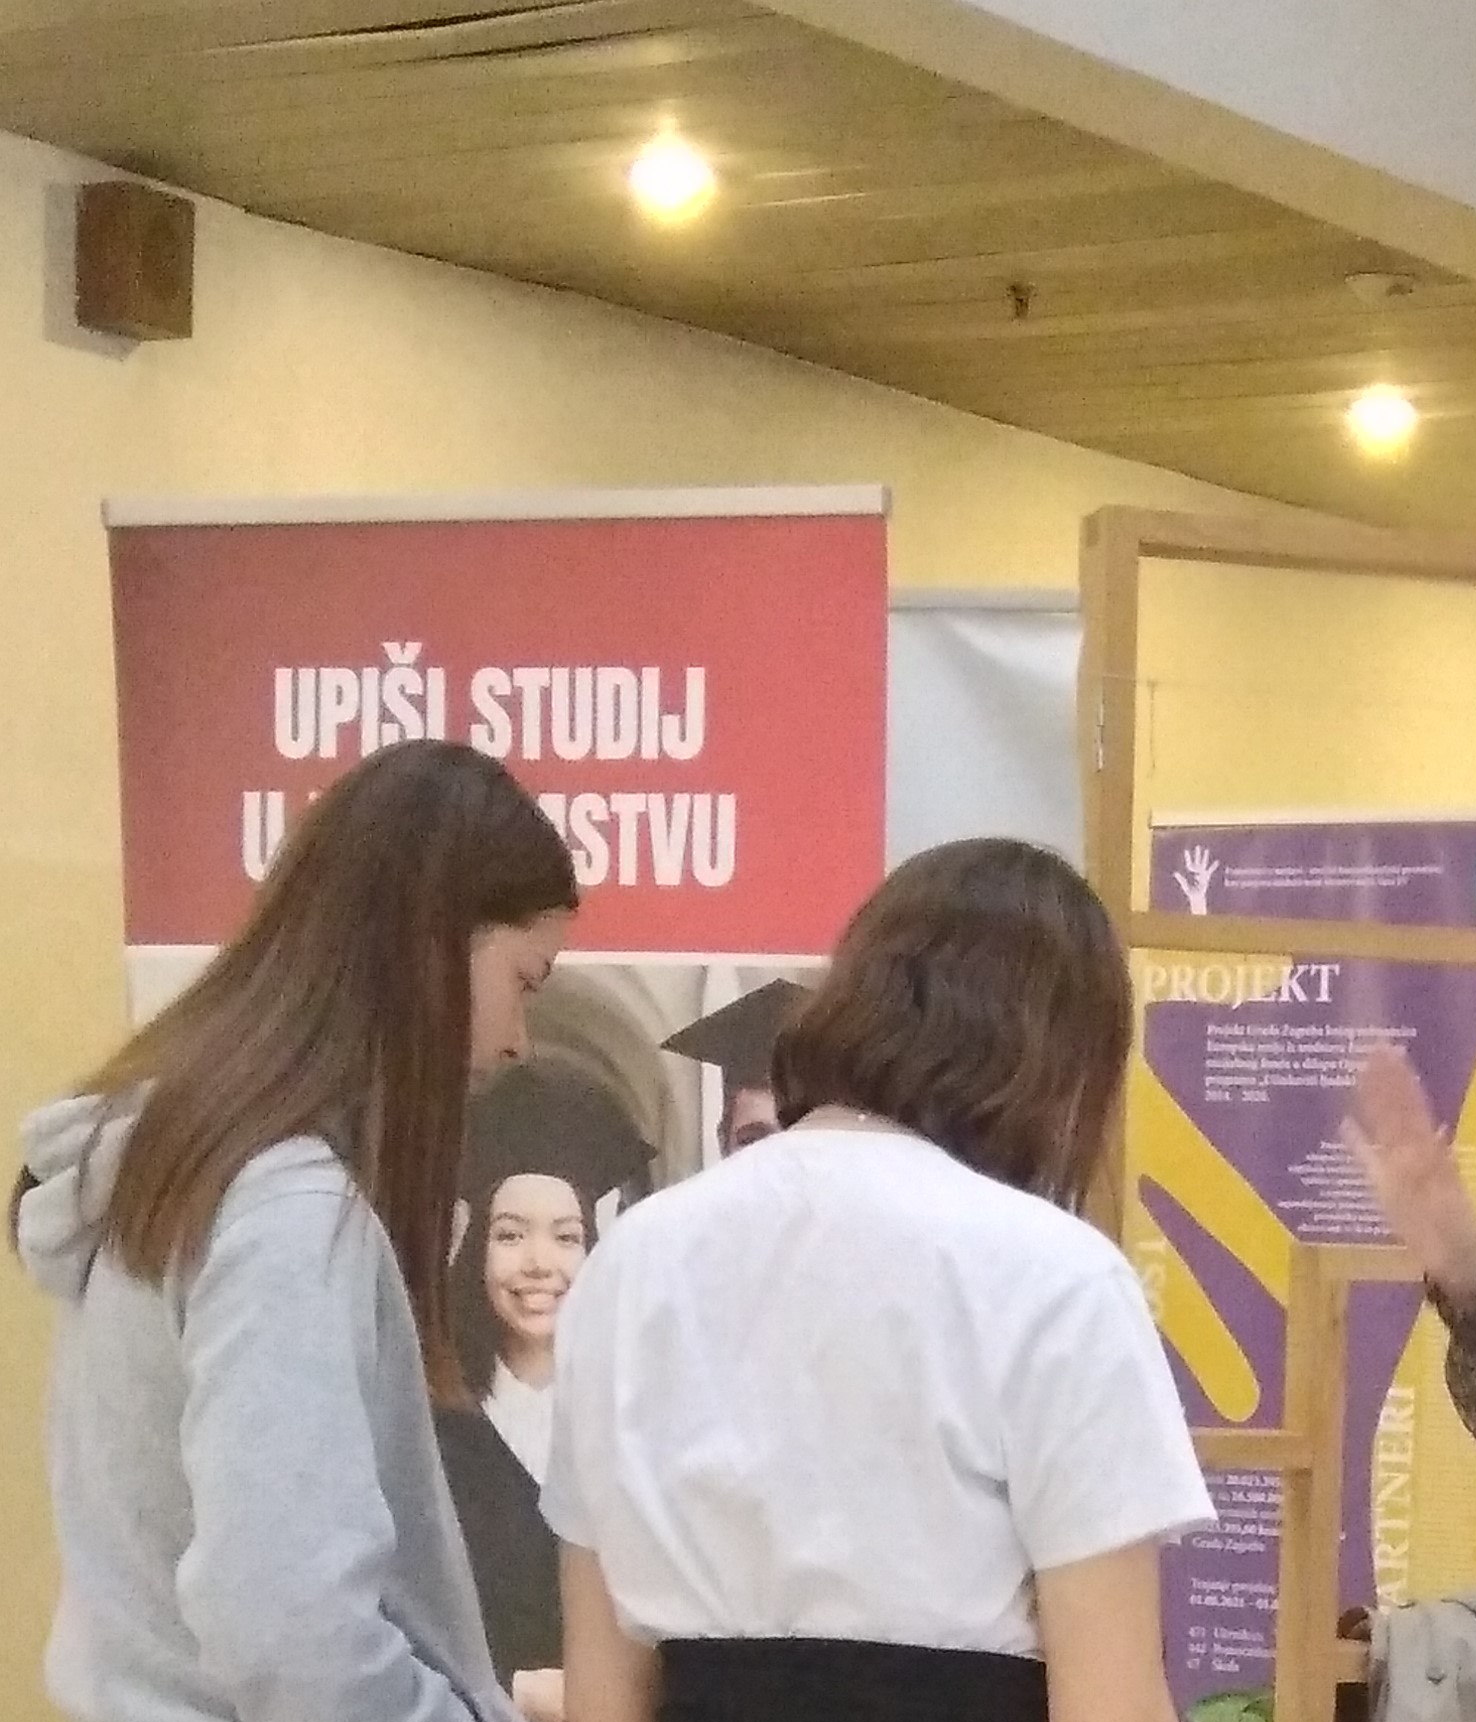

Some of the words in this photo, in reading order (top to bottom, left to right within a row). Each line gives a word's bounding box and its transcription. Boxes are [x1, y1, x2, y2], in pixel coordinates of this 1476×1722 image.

[275, 642, 445, 759] UPIŠI
[470, 666, 705, 761] STUDIJ
[242, 791, 286, 882] U
[1143, 963, 1340, 1011] PROJEKT
[1374, 1386, 1415, 1612] ARTNERI
